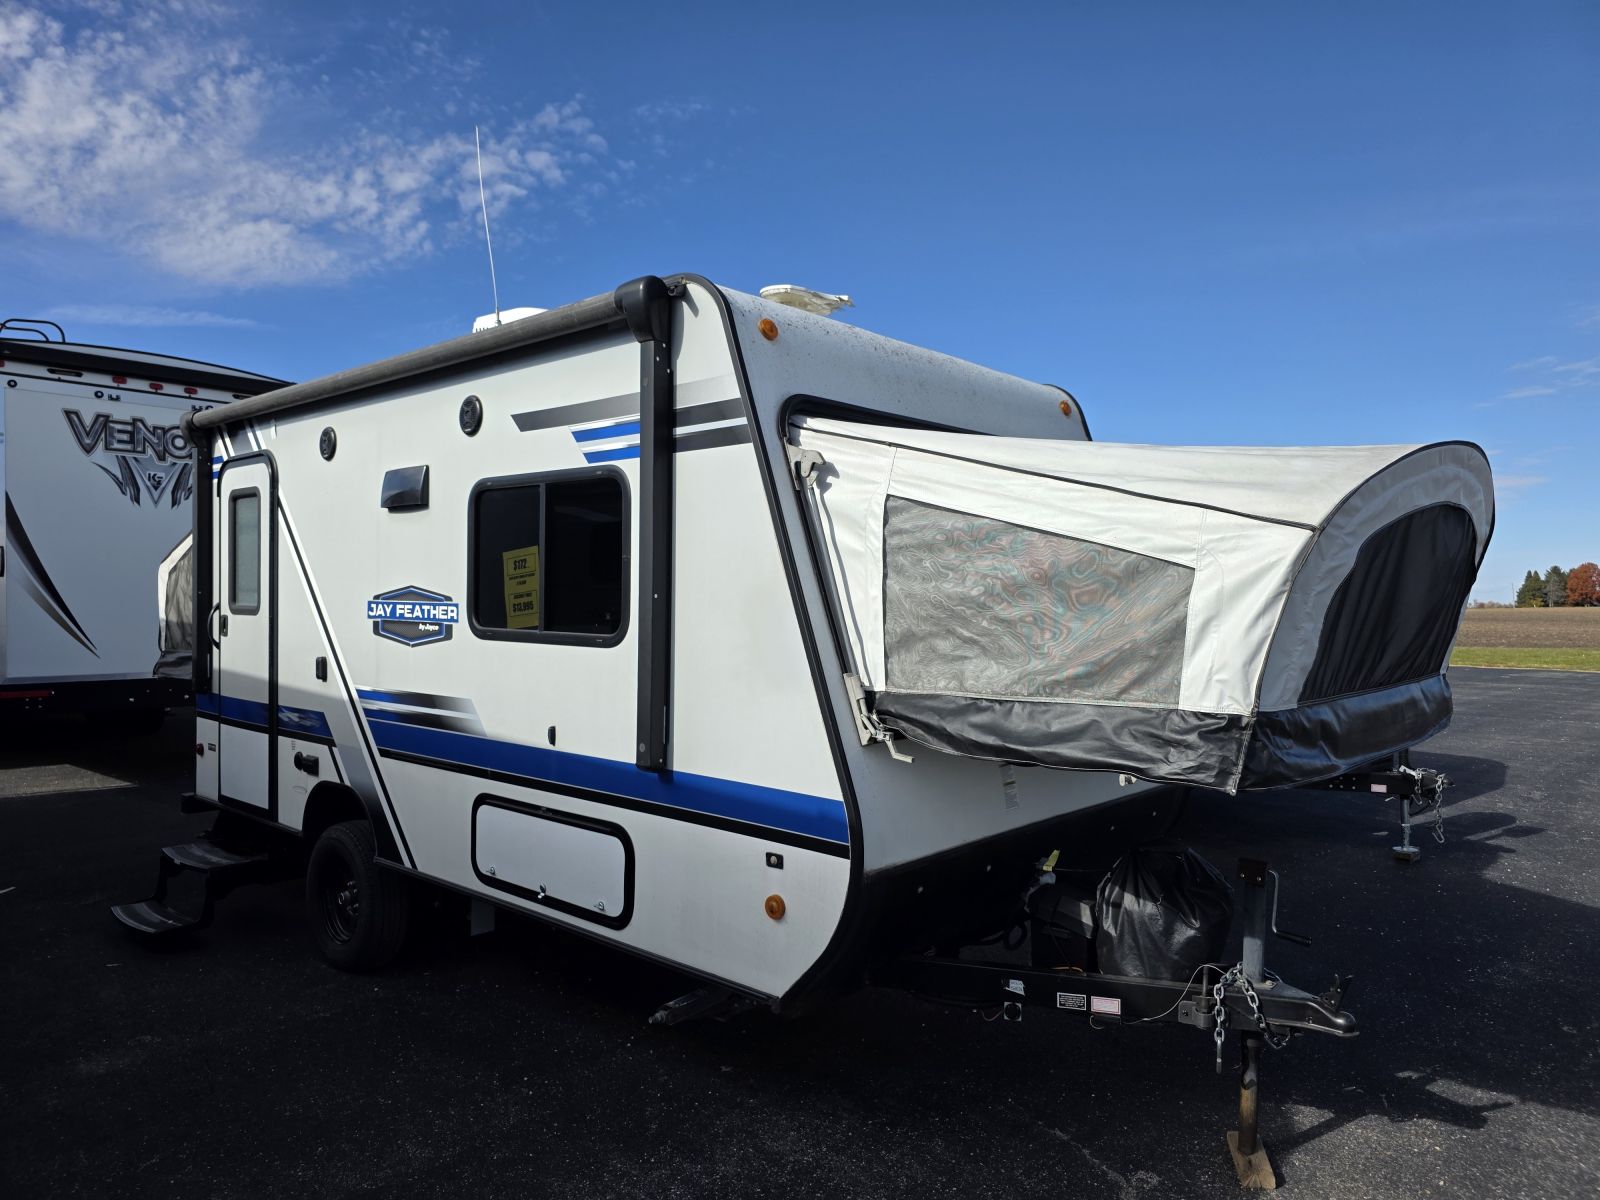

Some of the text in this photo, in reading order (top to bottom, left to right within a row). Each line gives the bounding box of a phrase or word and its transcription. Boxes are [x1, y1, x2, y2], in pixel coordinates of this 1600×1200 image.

[368, 603, 458, 620] JAY FEATHER
[418, 623, 426, 632] by
